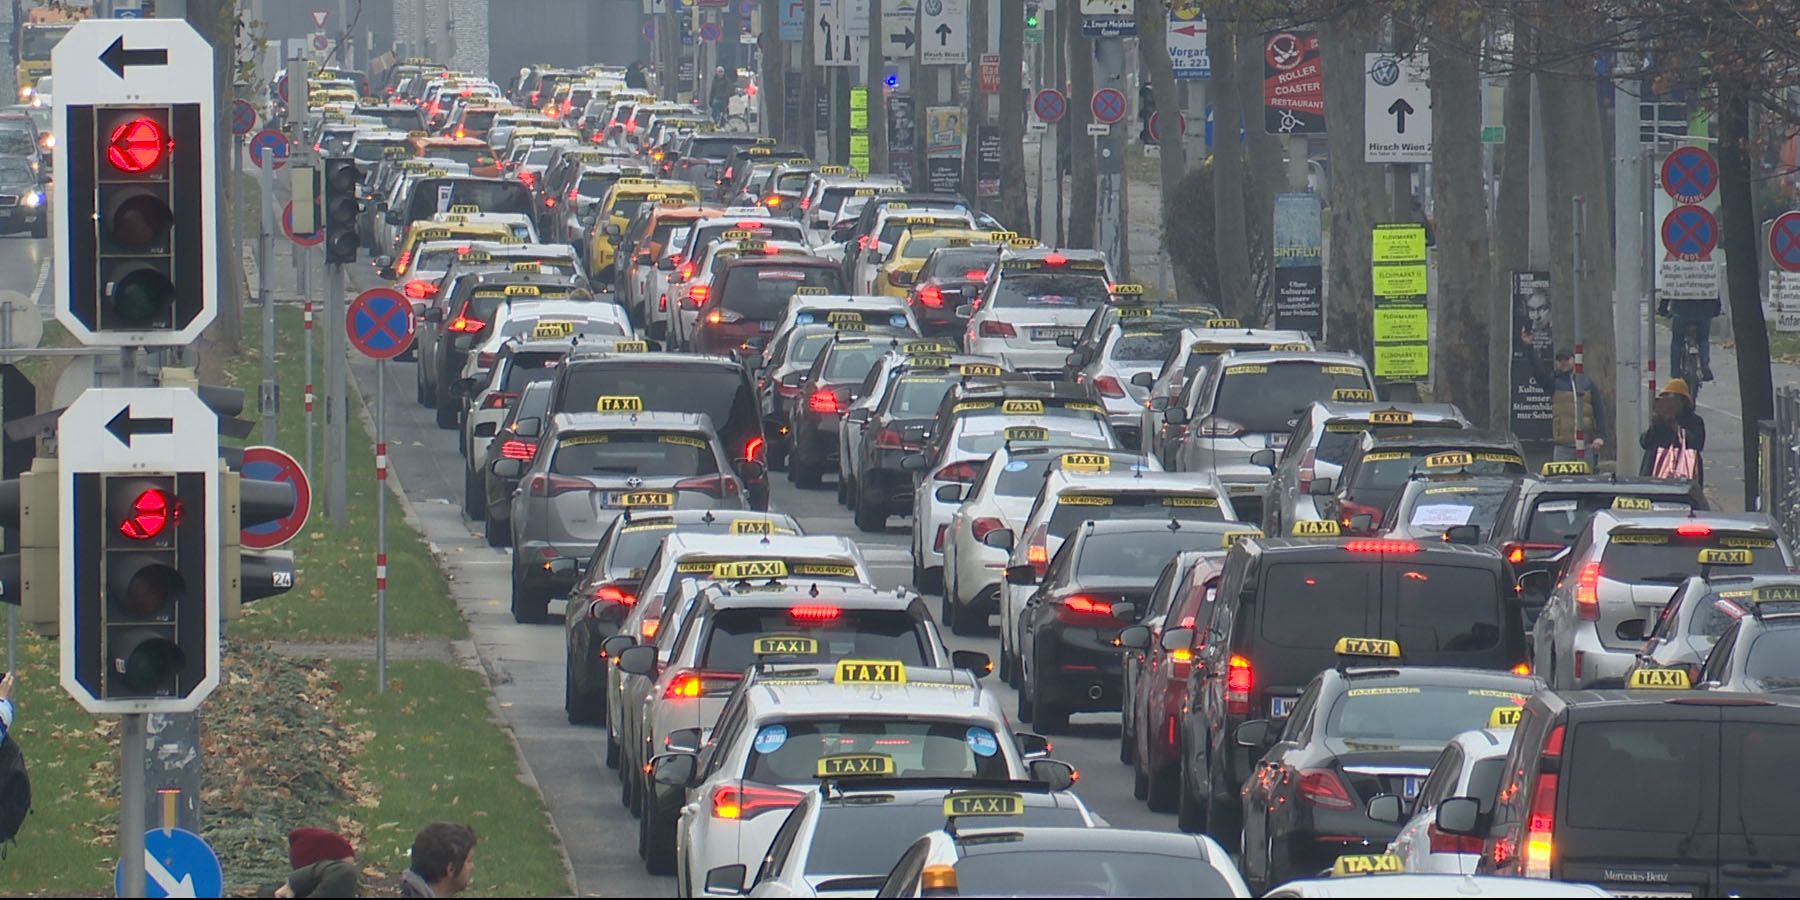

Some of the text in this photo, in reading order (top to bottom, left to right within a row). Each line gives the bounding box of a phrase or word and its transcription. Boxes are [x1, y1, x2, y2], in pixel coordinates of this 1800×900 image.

[1278, 65, 1316, 84] ROLLER
[1274, 82, 1320, 95] COASTER
[1271, 98, 1324, 108] RESTAURANT
[1370, 143, 1399, 151] Hirsch
[1402, 143, 1424, 151] Wien
[1674, 192, 1704, 203] ANFANG
[1211, 320, 1236, 328] TAXI
[1340, 391, 1368, 399] TAXI
[606, 400, 637, 410] TAXI
[1008, 402, 1039, 410] TAXI
[1378, 414, 1406, 422] TAXI
[1013, 430, 1040, 438] TAXI
[1070, 456, 1104, 464] TAXI
[1436, 456, 1466, 464] TAXI
[1552, 464, 1584, 473] TAXI
[632, 494, 662, 504] TAXI
[1620, 499, 1650, 509] TAXI
[740, 522, 768, 533] TAXI
[1300, 522, 1335, 534] TAXI
[1710, 552, 1744, 562] TAXI
[741, 562, 780, 574] TAXI
[274, 573, 290, 586] 24
[1764, 590, 1798, 600] TAXI
[767, 641, 805, 652] TAXI
[1348, 640, 1389, 654] TAXI
[846, 665, 897, 681] TAXI
[1640, 672, 1682, 686] TAXI
[1502, 711, 1522, 724] TA
[833, 760, 878, 772] TAXI
[961, 799, 1007, 812] TAXI
[1344, 854, 1397, 872] TAXI
[1604, 870, 1668, 882] Mercedes-Benz
